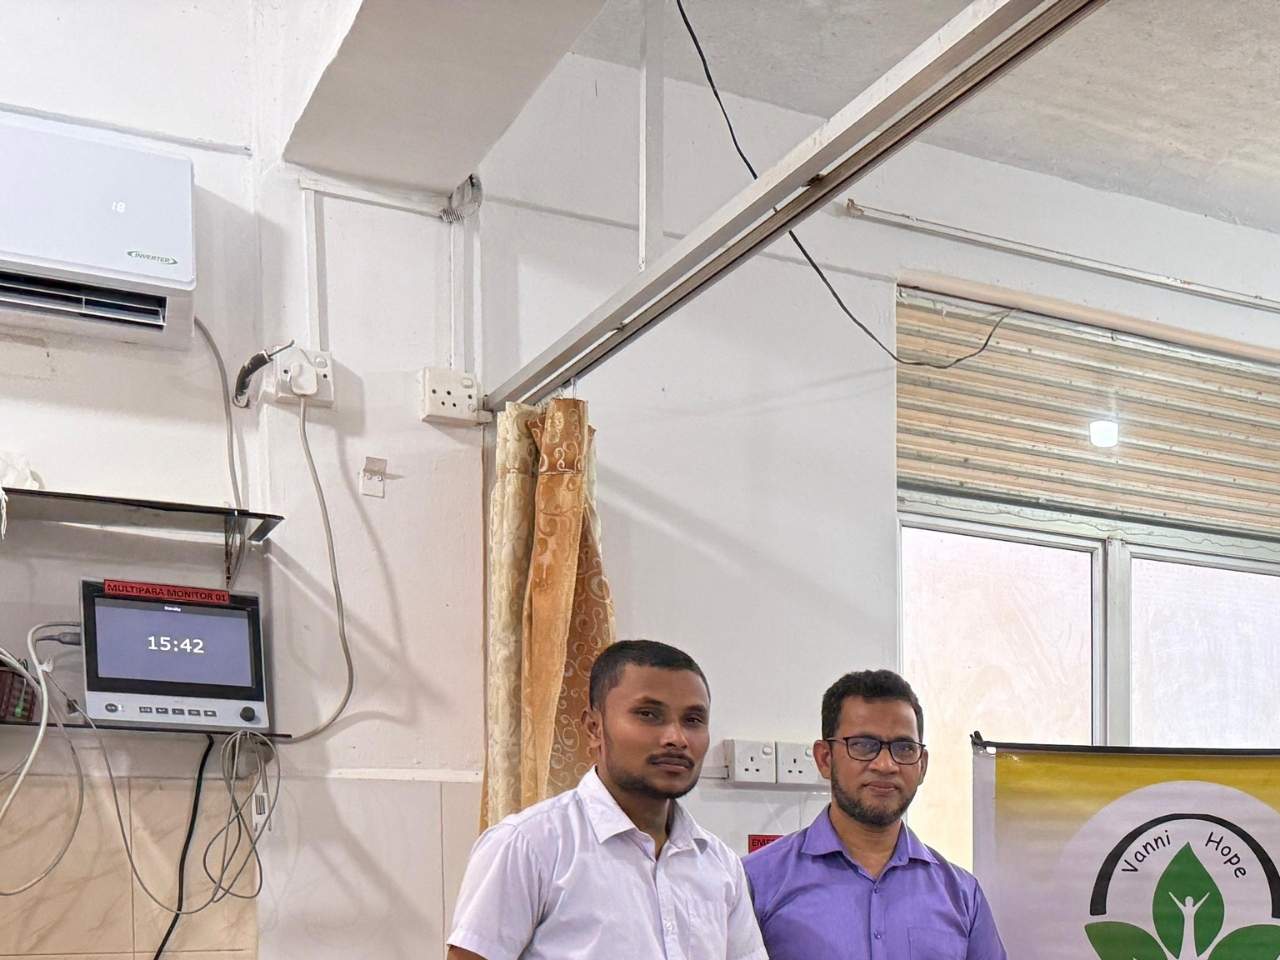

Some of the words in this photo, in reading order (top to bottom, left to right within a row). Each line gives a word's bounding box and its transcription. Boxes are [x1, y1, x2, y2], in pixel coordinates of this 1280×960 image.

[134, 250, 171, 263] INVERTER
[107, 583, 164, 596] MULTIPARA
[166, 588, 213, 600] MONITOR
[215, 592, 226, 601] 01
[148, 636, 204, 654] 15:42
[1121, 829, 1173, 876] Vanni
[1205, 831, 1247, 879] Hope
